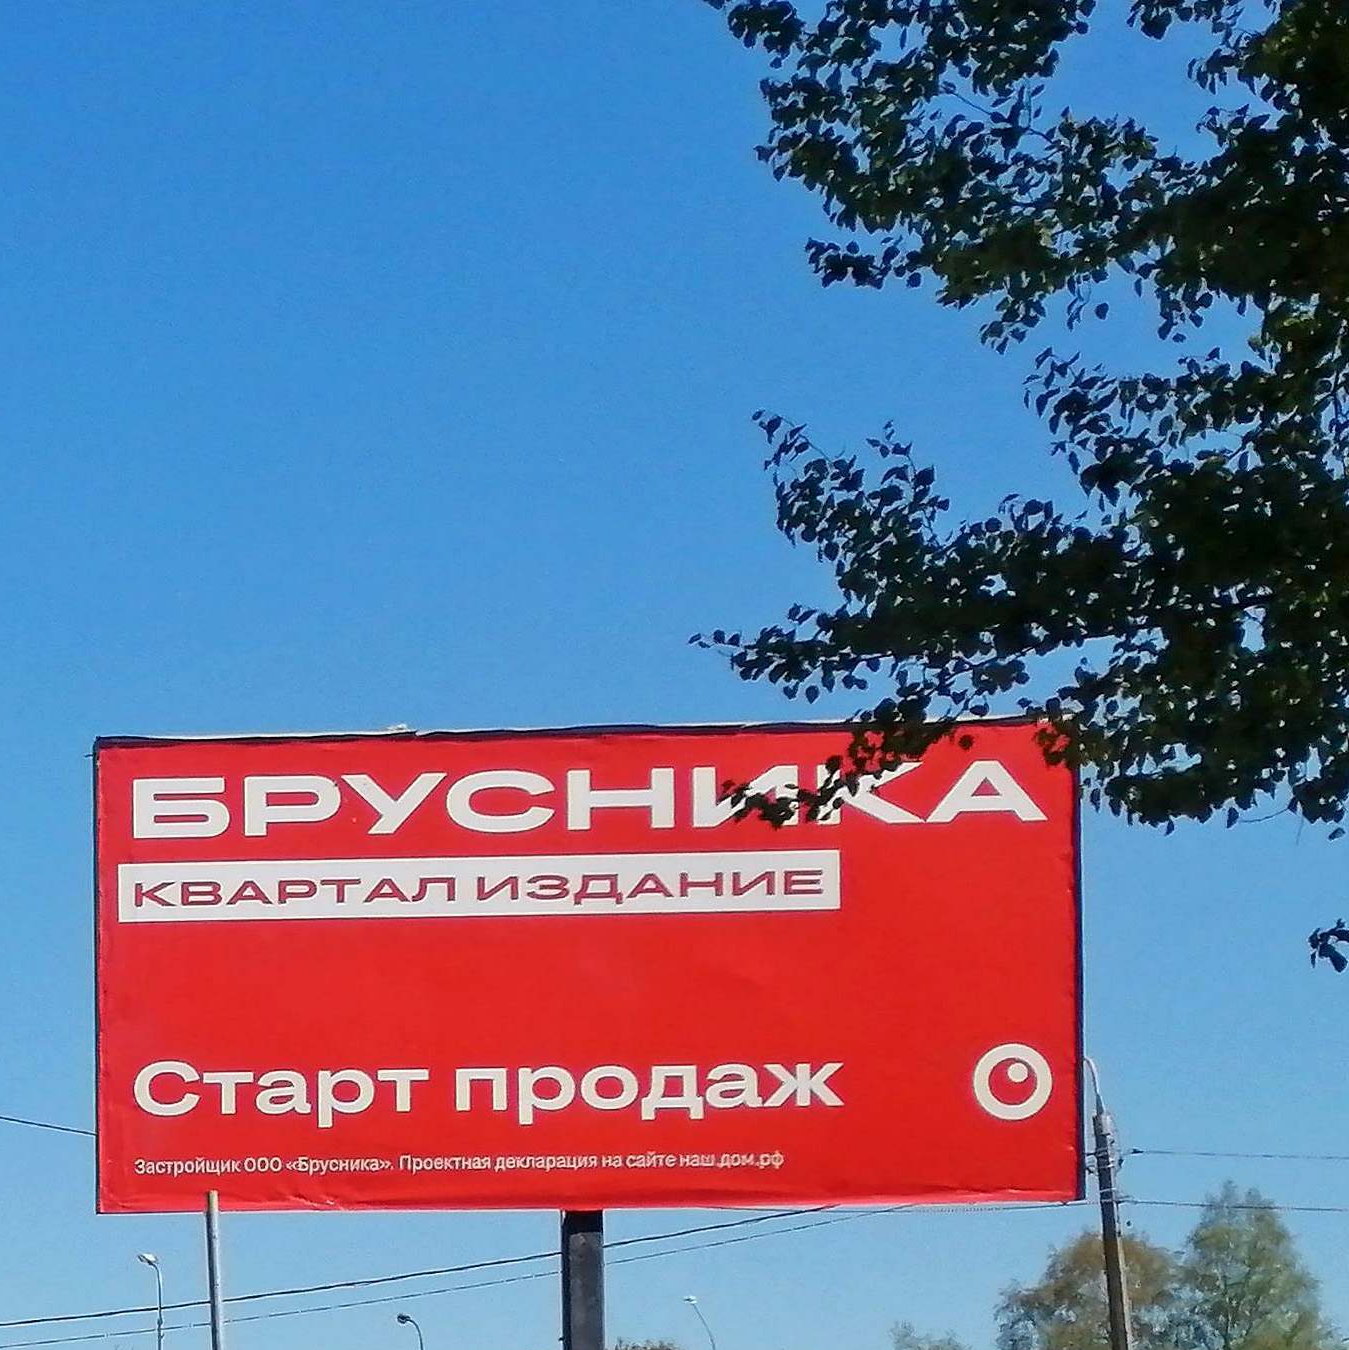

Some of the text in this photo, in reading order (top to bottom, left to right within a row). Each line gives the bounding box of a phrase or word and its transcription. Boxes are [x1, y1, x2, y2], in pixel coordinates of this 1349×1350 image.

[133, 760, 1048, 839] БРУСНИКА
[134, 869, 824, 907] КВАРТАЛ ИЗДАНИЕ
[133, 1060, 845, 1129] Старт продаж
[134, 1157, 241, 1177] Застройщик
[244, 1156, 283, 1172] ООО
[398, 1154, 491, 1174] Проектная
[494, 1153, 598, 1172] декларация
[601, 1153, 623, 1168] на
[626, 1151, 676, 1169] сайте
